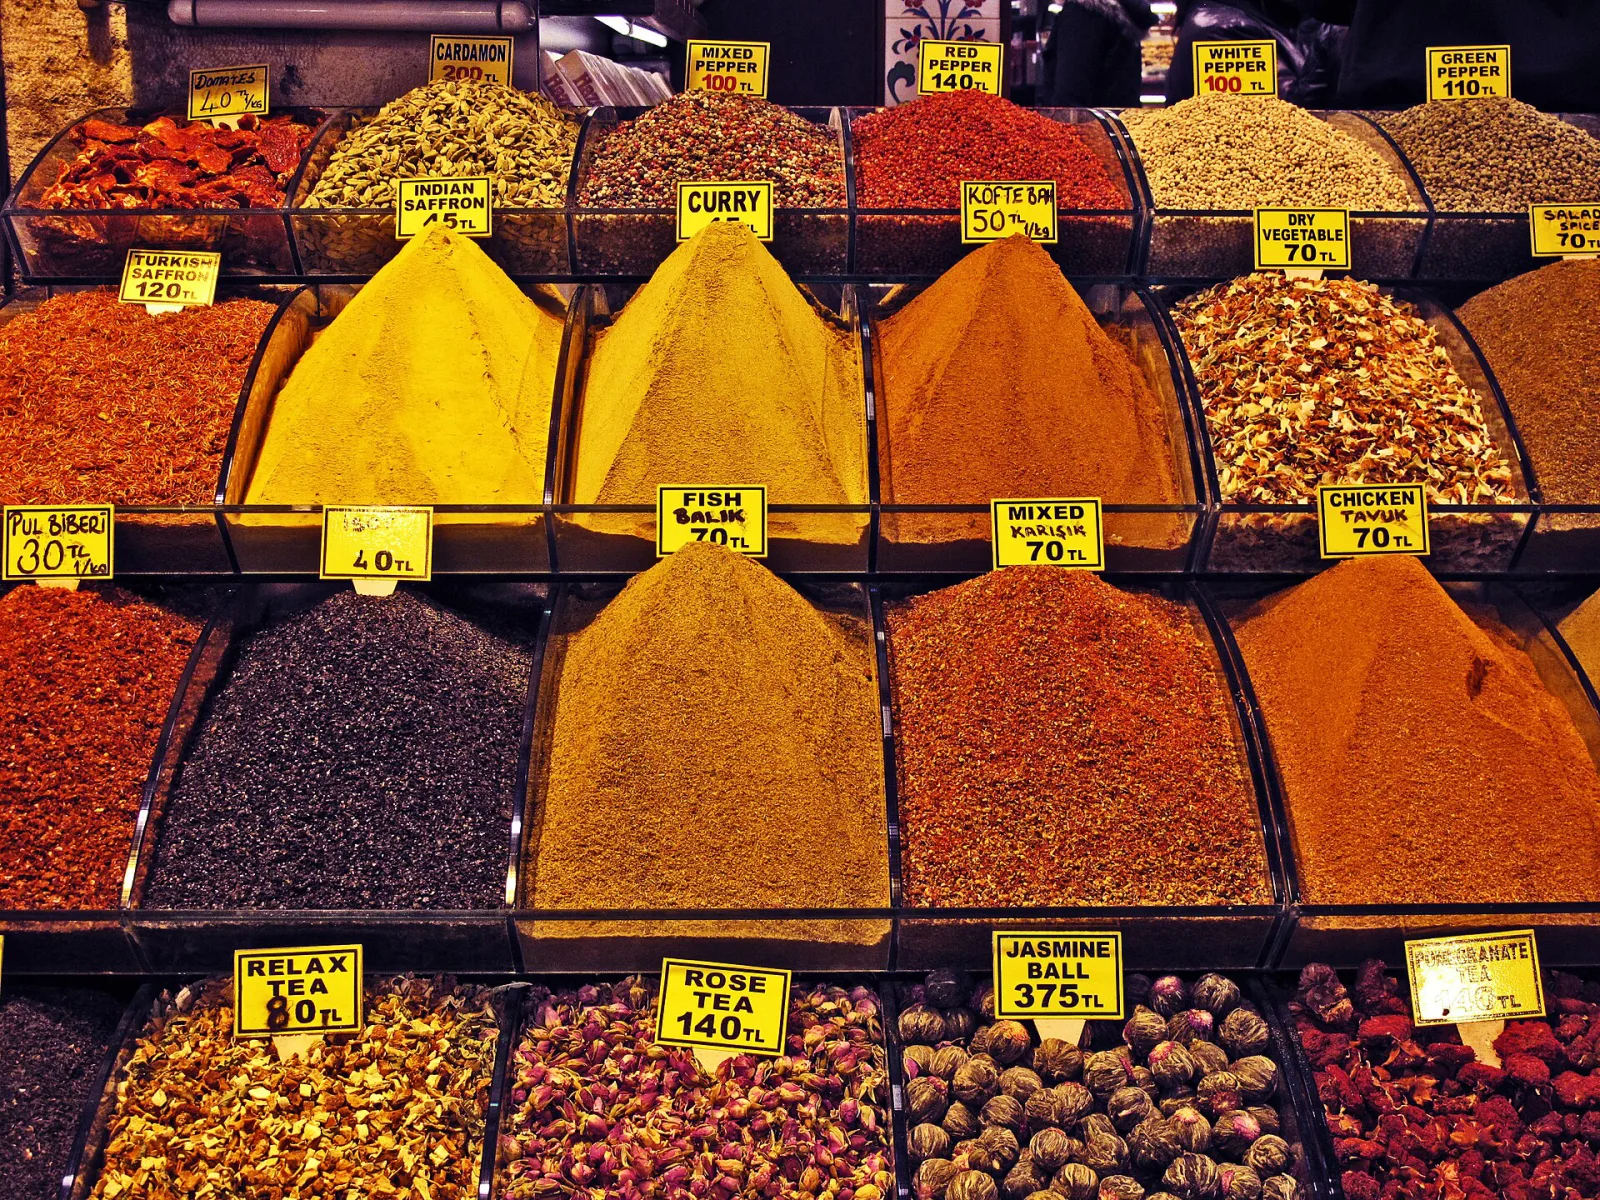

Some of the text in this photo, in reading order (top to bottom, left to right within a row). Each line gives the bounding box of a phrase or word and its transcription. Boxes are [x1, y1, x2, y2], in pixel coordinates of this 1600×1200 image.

[437, 42, 506, 62] CARDAMON
[702, 47, 753, 59] MIXED
[945, 46, 978, 58] RED
[1209, 47, 1262, 59] WHITE
[1441, 52, 1497, 64] GREEN
[695, 60, 758, 73] PEPPER
[929, 59, 992, 73] PEPPER
[1204, 61, 1267, 73] PEPPER
[1437, 66, 1500, 78] PEPPER
[195, 72, 256, 90] DOMATES
[414, 183, 475, 196] INDIAN
[404, 197, 485, 211] SAFFRON
[688, 191, 761, 213] CURRY
[973, 210, 1005, 233] 50
[1008, 214, 1026, 224] TL
[1288, 213, 1315, 226] DRY
[1544, 209, 1600, 220] SALAD
[1560, 221, 1599, 231] SPICE
[1262, 229, 1343, 241] VEGETABLE
[134, 255, 212, 268] TURKISH
[131, 268, 210, 282] SAFFRON
[683, 492, 742, 507] FISH
[1329, 491, 1415, 507] CHICKEN
[1008, 506, 1085, 520] MIXED
[1340, 509, 1408, 524] TAVUK
[9, 511, 43, 537] PUL
[17, 538, 64, 575] 30
[66, 545, 90, 559] TL
[1006, 940, 1111, 959] JASMINE
[247, 956, 348, 977] RELAX
[1027, 962, 1089, 979] BALL
[266, 978, 328, 997] TEA
[684, 969, 767, 994] ROSE
[692, 991, 754, 1014] TEA
